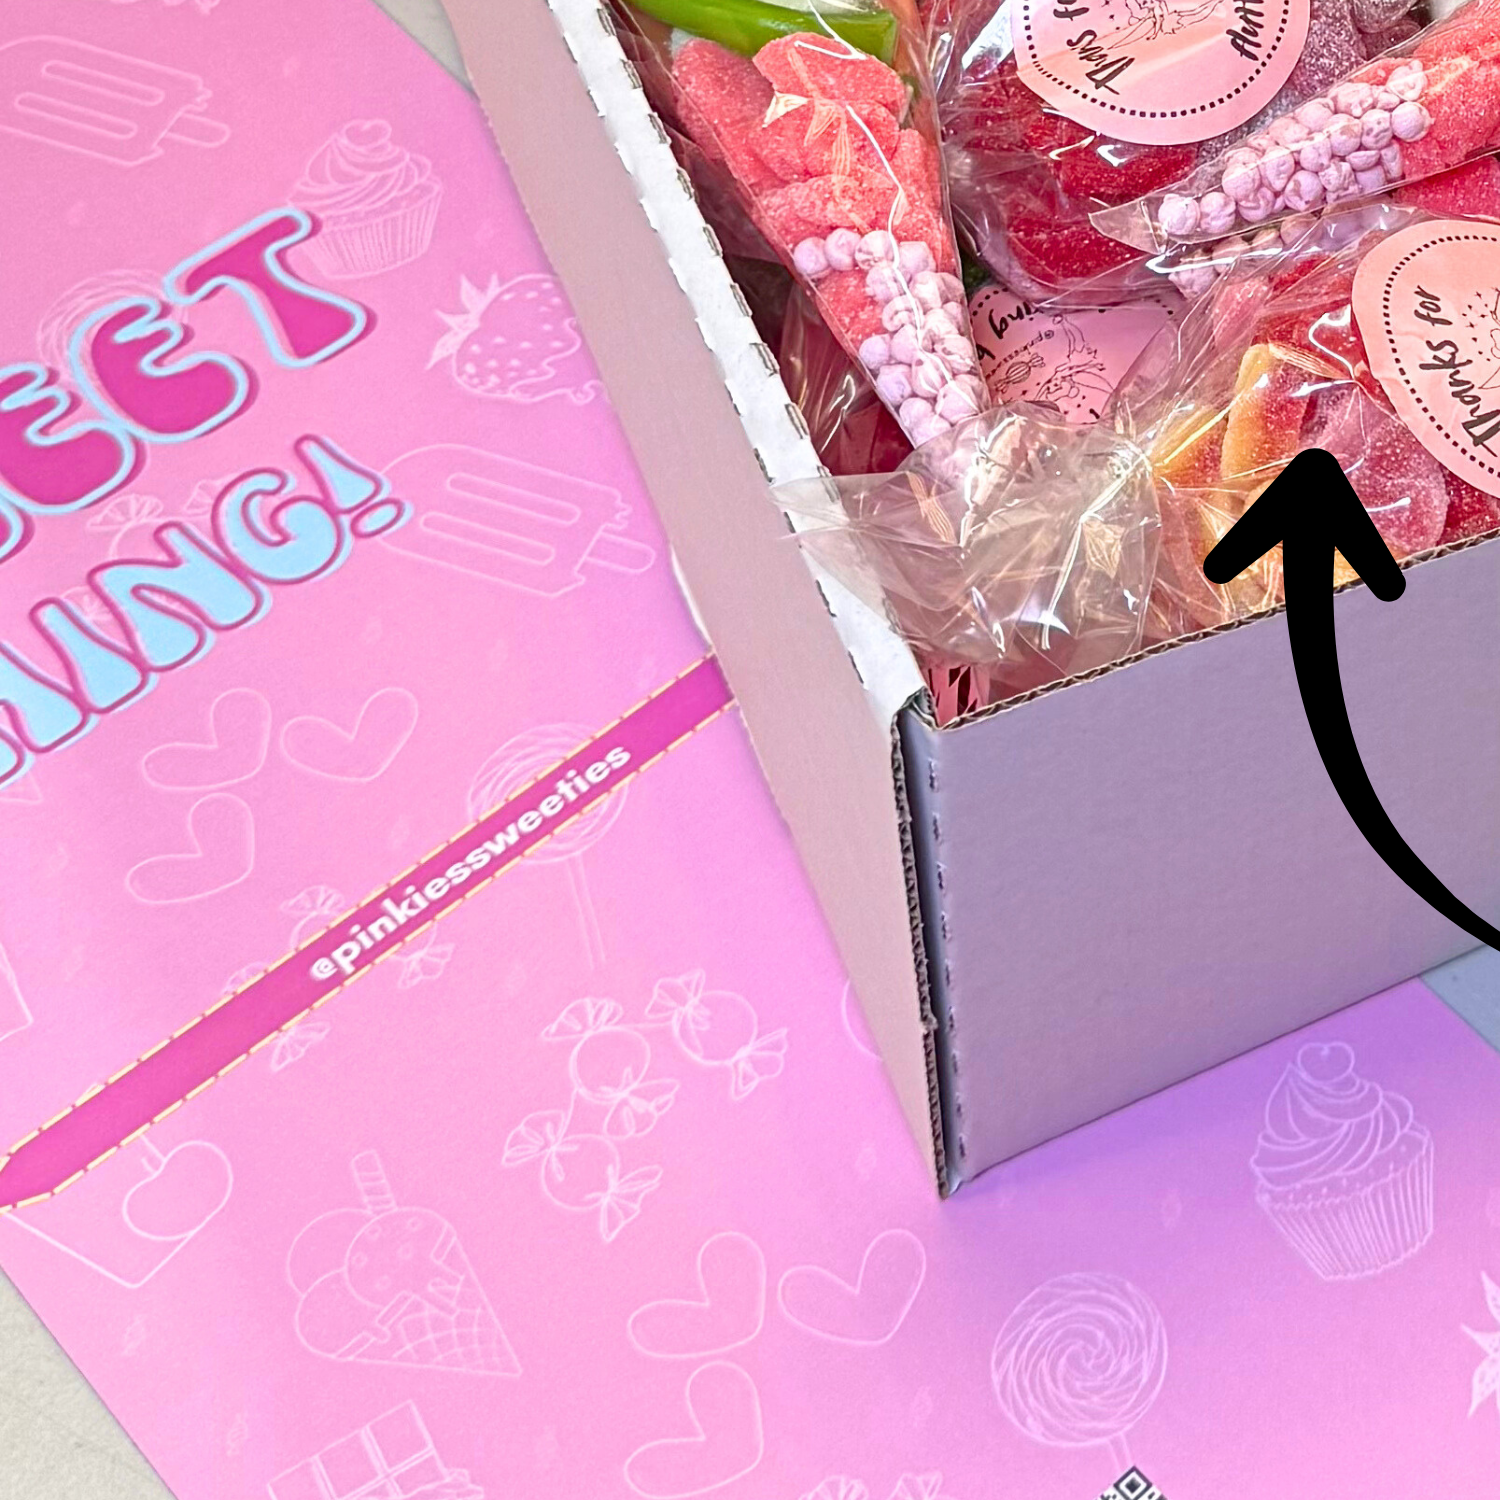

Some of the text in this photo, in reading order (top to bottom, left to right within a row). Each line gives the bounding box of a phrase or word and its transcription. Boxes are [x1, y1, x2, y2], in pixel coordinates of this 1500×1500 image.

[0, 207, 376, 563] EET
[1414, 285, 1453, 326] for
[310, 746, 631, 981] @pinkiessweeties
